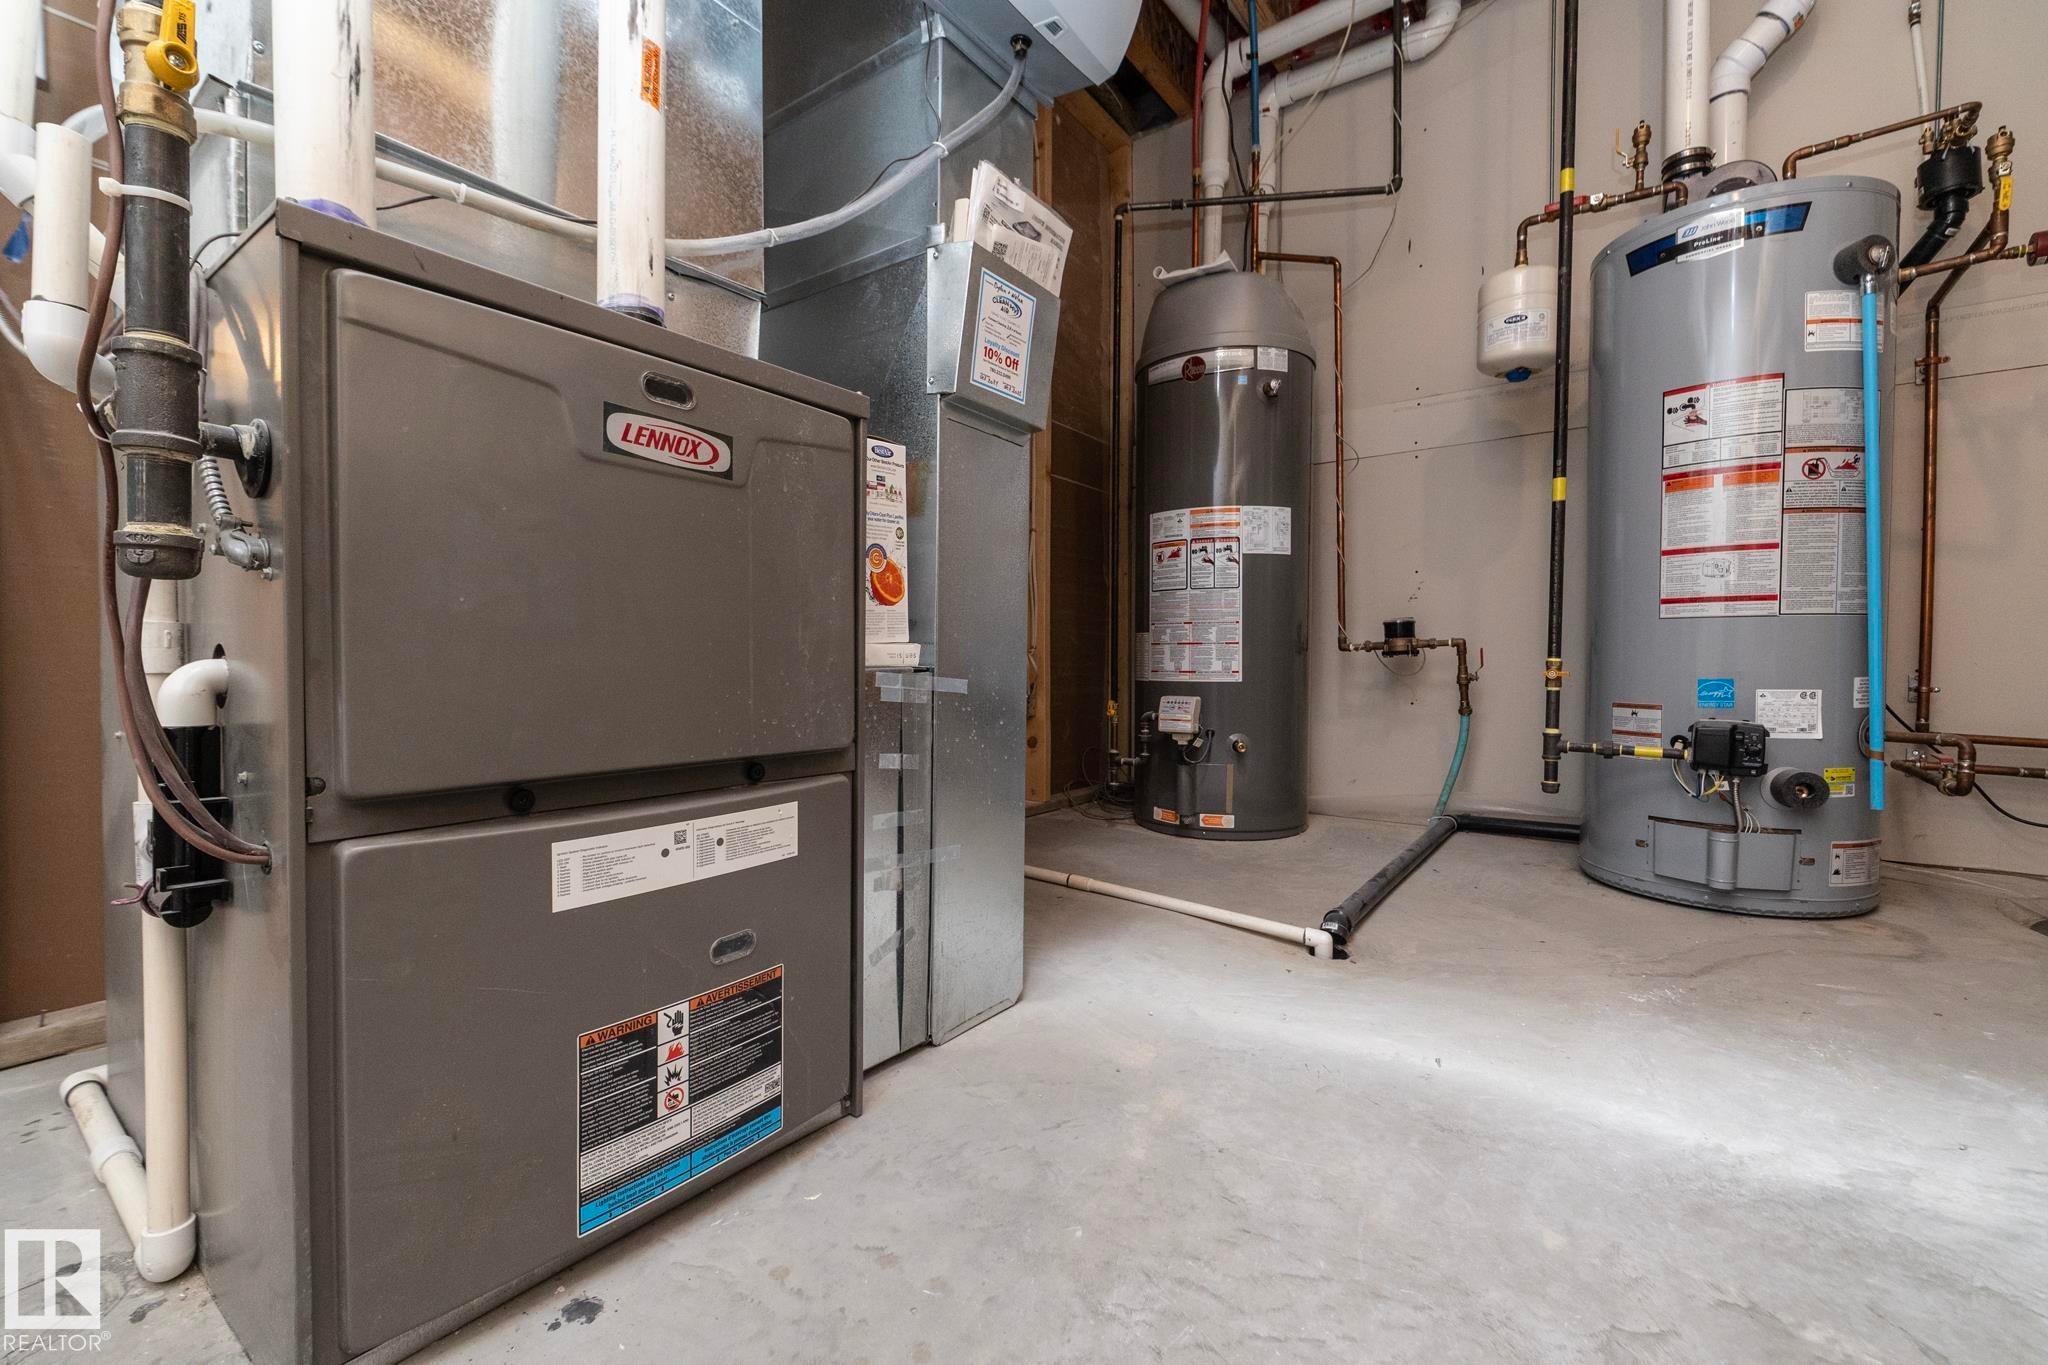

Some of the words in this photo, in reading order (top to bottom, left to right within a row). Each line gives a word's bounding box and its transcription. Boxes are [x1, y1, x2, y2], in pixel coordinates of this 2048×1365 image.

[984, 346, 1002, 364] 10%
[1005, 356, 1019, 372] Off
[621, 422, 701, 460] LENNOX
[706, 972, 776, 1004] AVERTISSEMENT
[597, 1016, 652, 1041] WARNING
